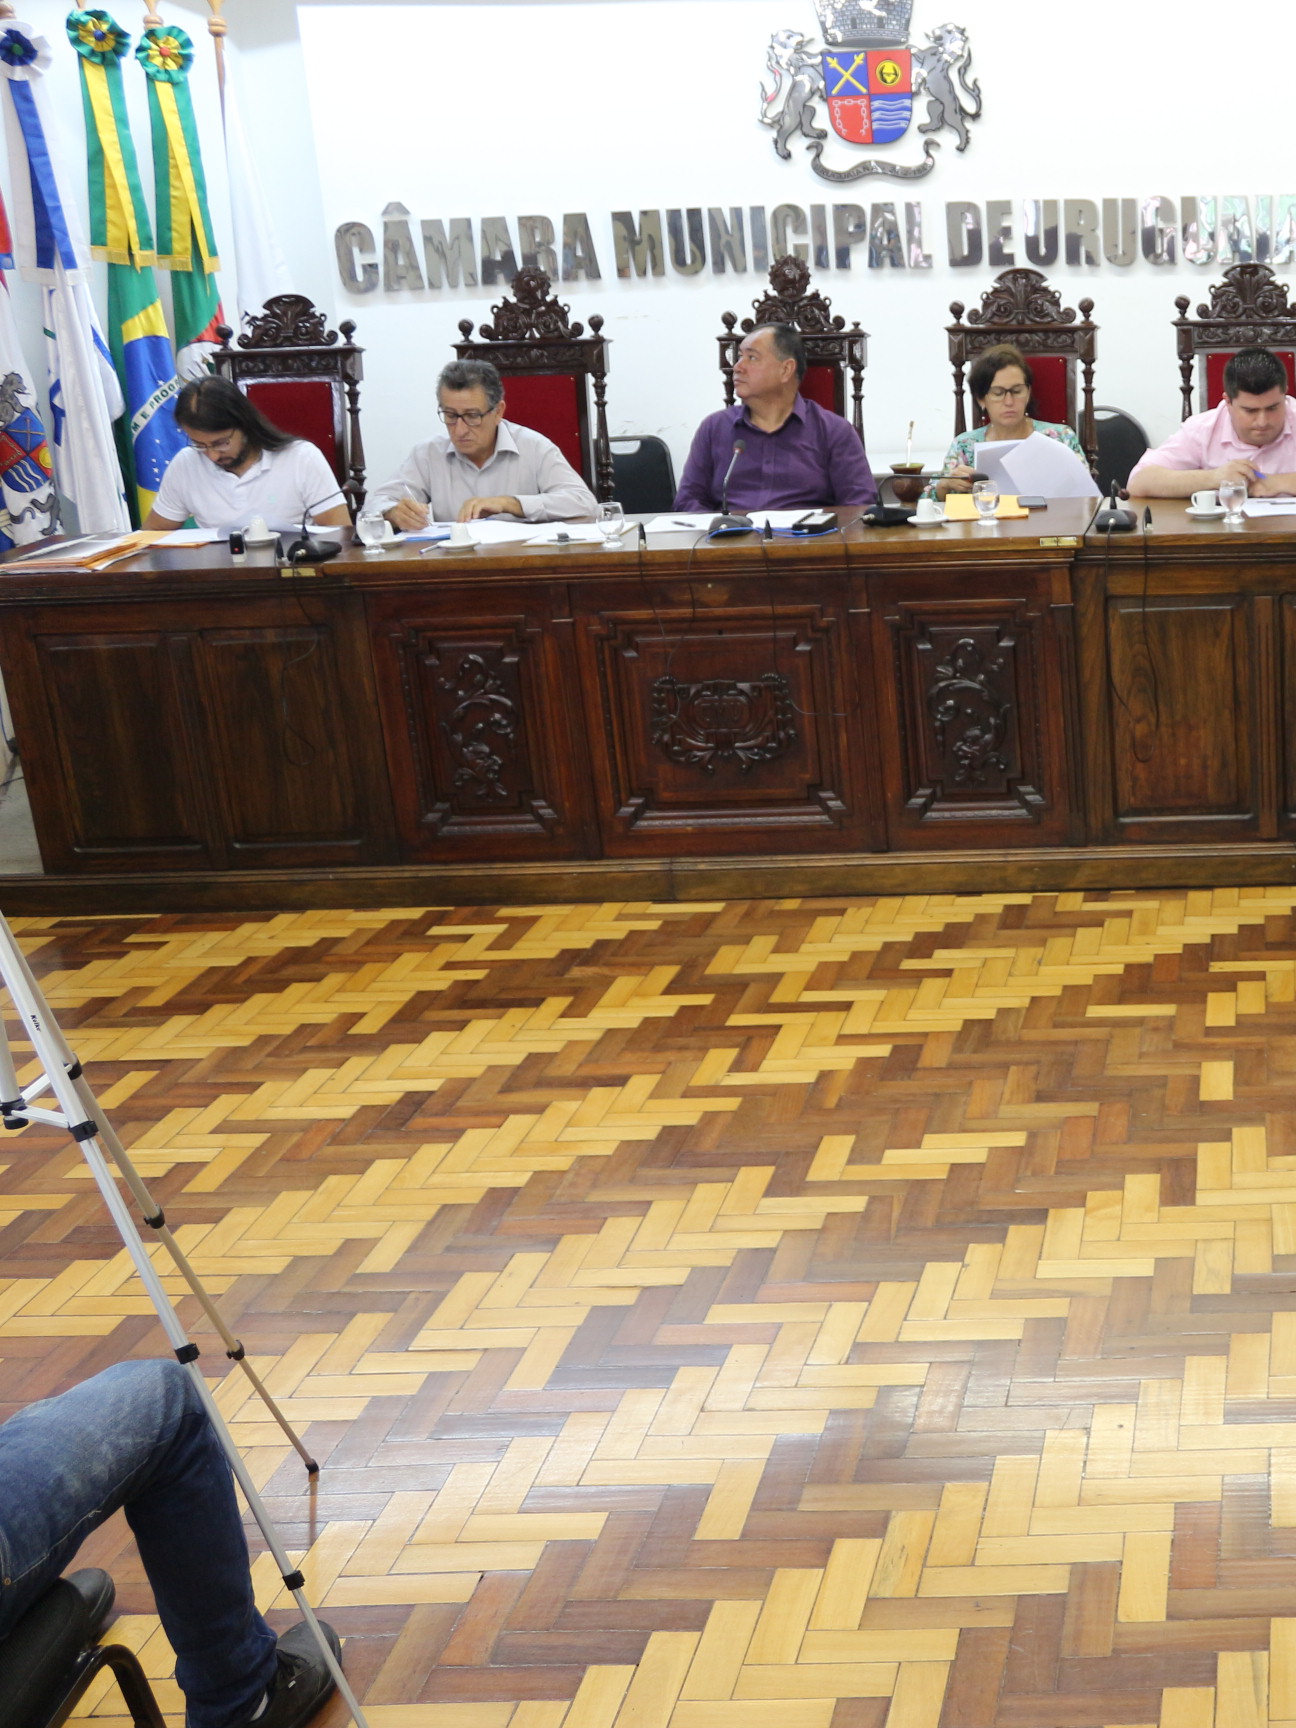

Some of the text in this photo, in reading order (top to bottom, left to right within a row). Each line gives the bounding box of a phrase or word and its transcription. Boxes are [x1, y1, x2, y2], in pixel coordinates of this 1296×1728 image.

[334, 201, 601, 294] CÂMARA
[610, 201, 933, 279] MUNICIPAL
[946, 200, 1016, 267] DE
